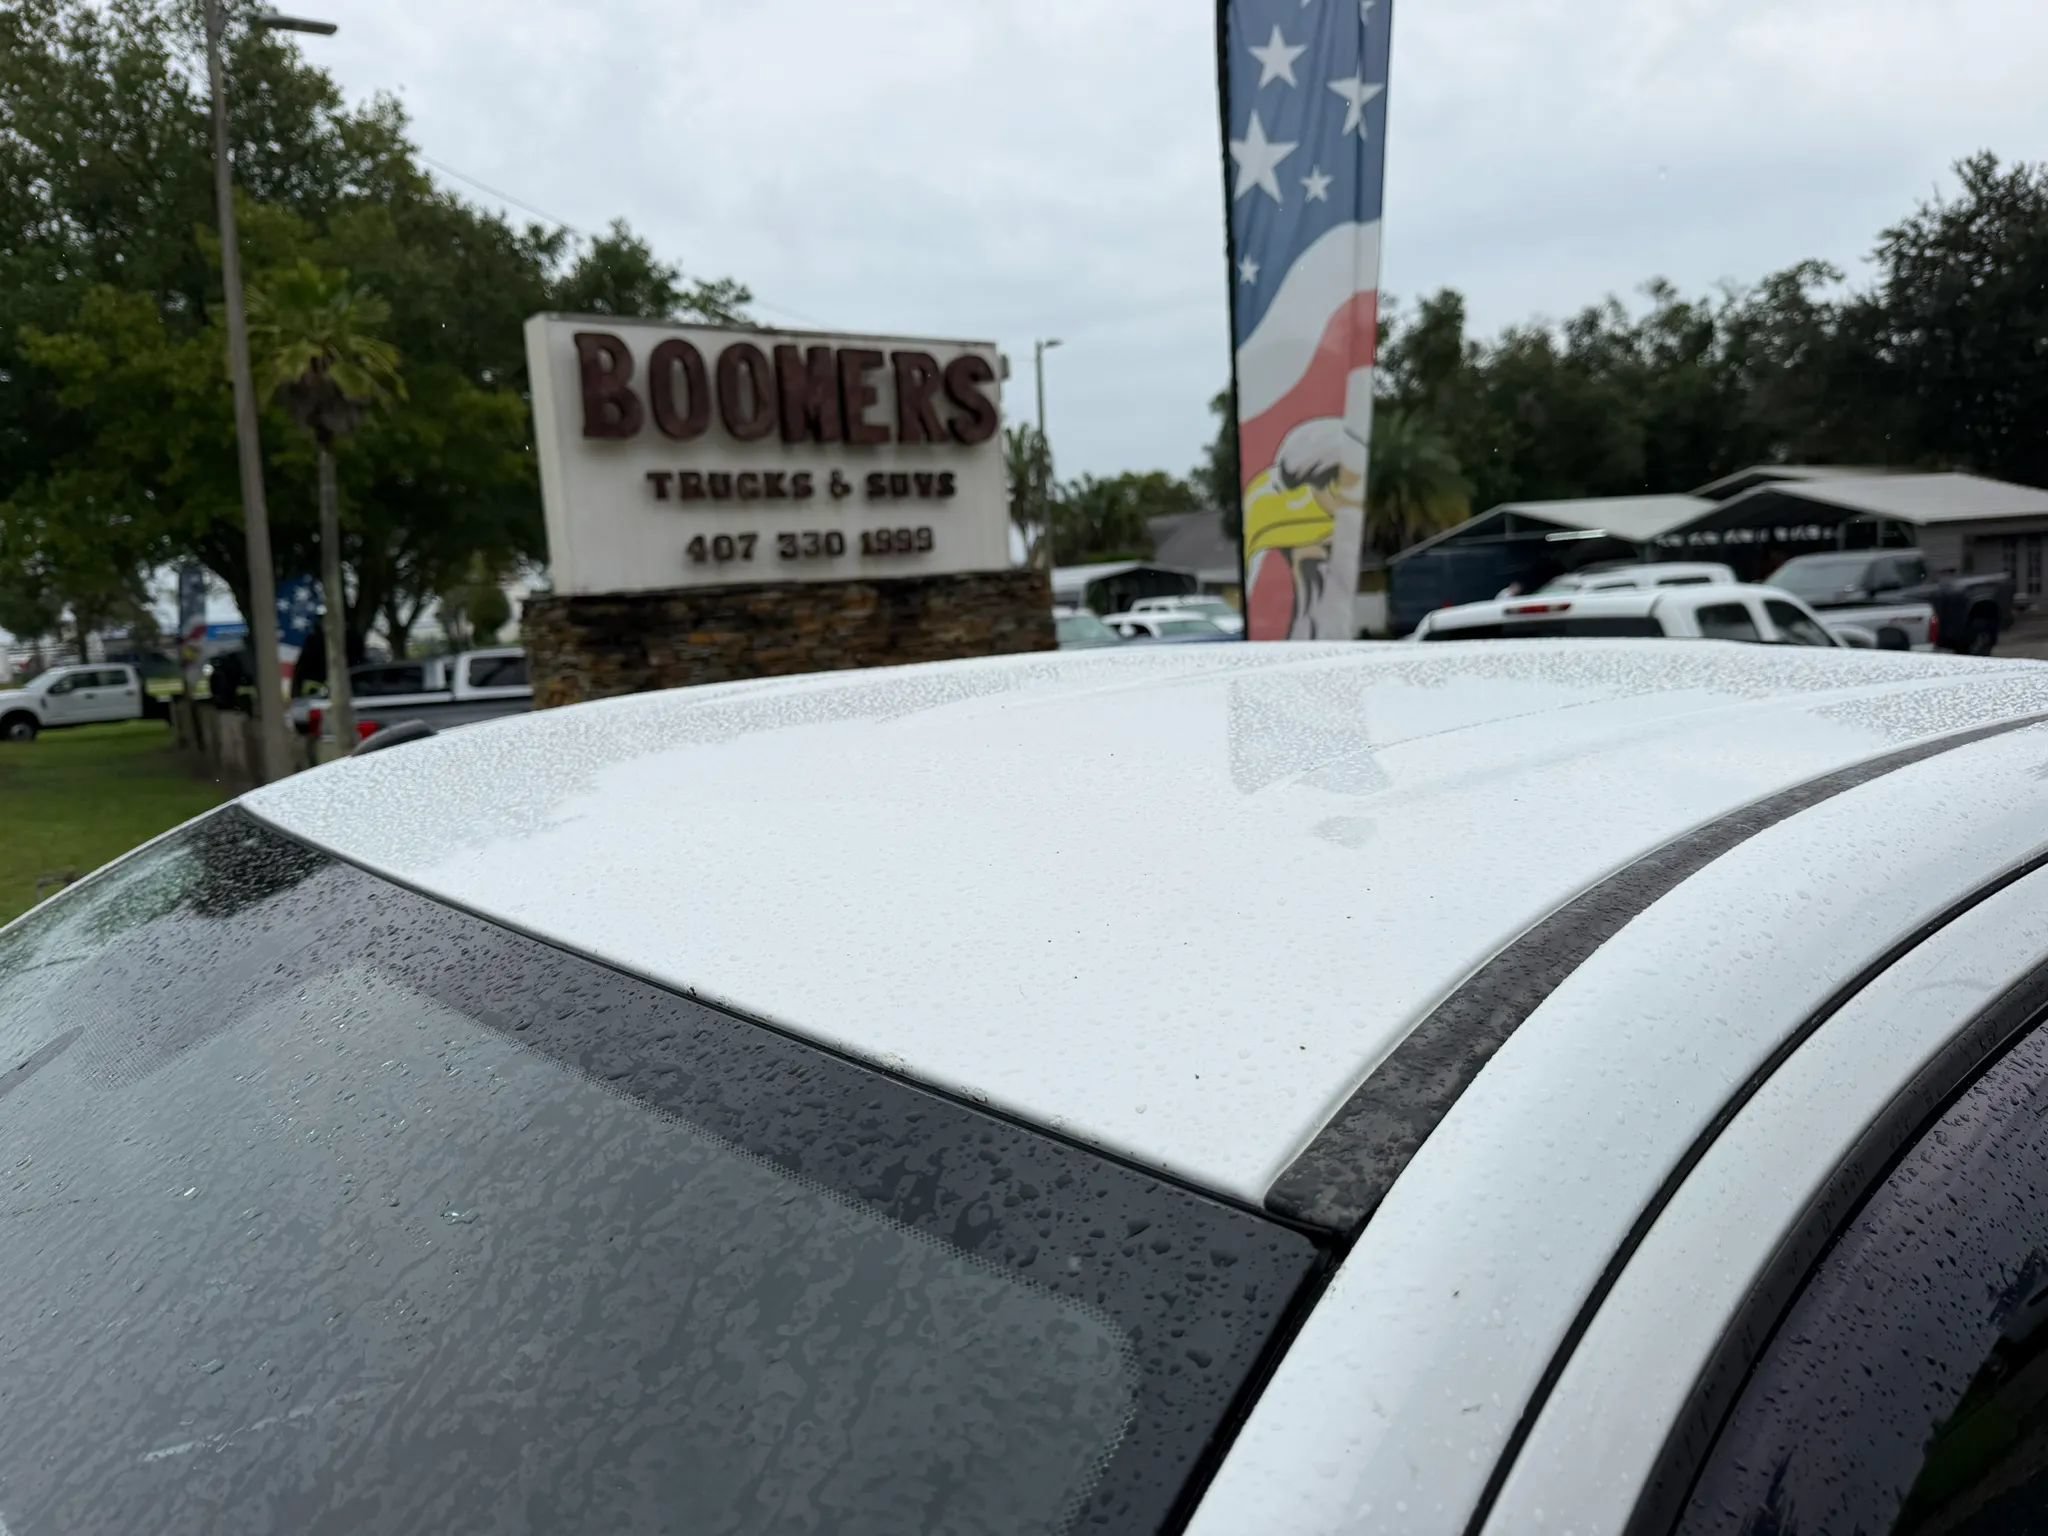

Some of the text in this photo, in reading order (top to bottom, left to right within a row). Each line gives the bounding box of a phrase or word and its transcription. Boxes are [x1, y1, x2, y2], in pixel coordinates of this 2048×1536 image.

[574, 332, 998, 445] BOOMERS
[646, 468, 956, 499] TRUCKS & SUVS
[685, 526, 933, 563] 407 330 1999
